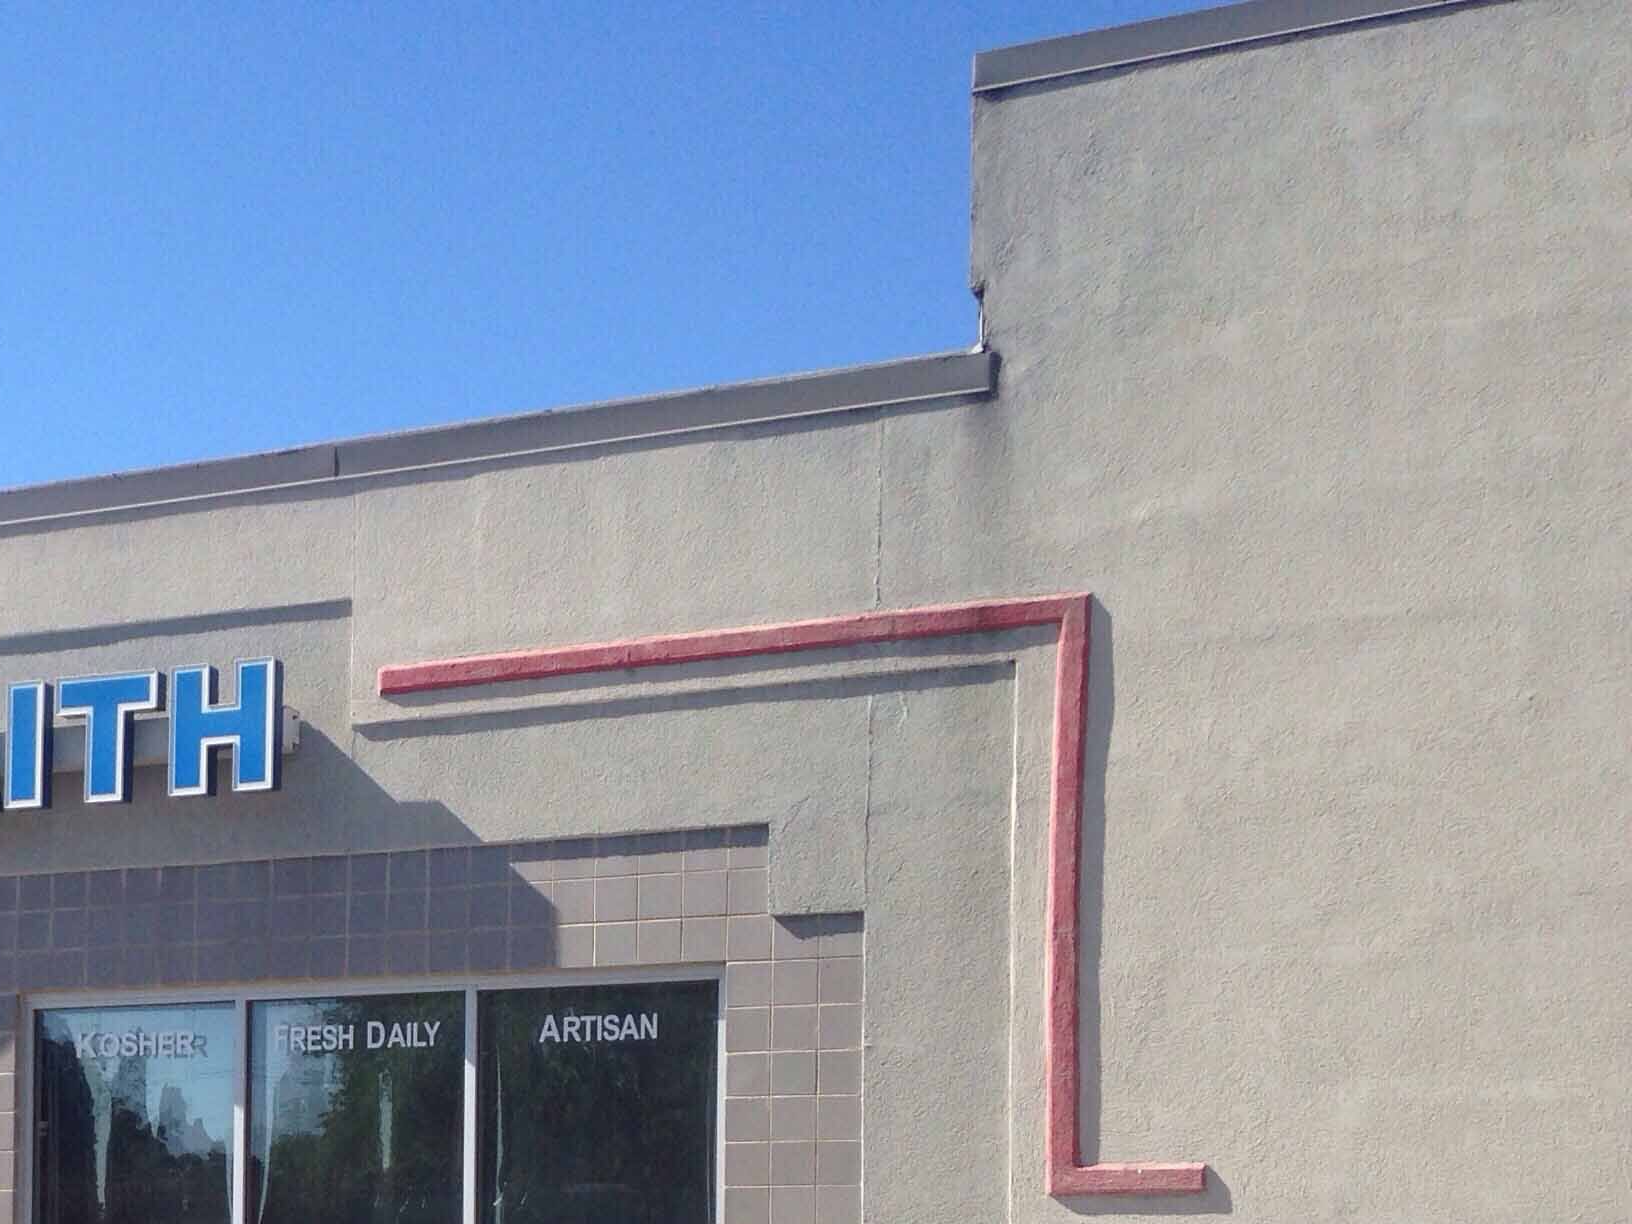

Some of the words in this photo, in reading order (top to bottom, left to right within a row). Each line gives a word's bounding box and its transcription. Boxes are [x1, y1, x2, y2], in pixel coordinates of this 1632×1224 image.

[274, 1024, 354, 1053] FRESH
[367, 1020, 442, 1051] DAILY
[538, 1012, 659, 1044] ARTISAN
[74, 1031, 194, 1059] KOSHER
